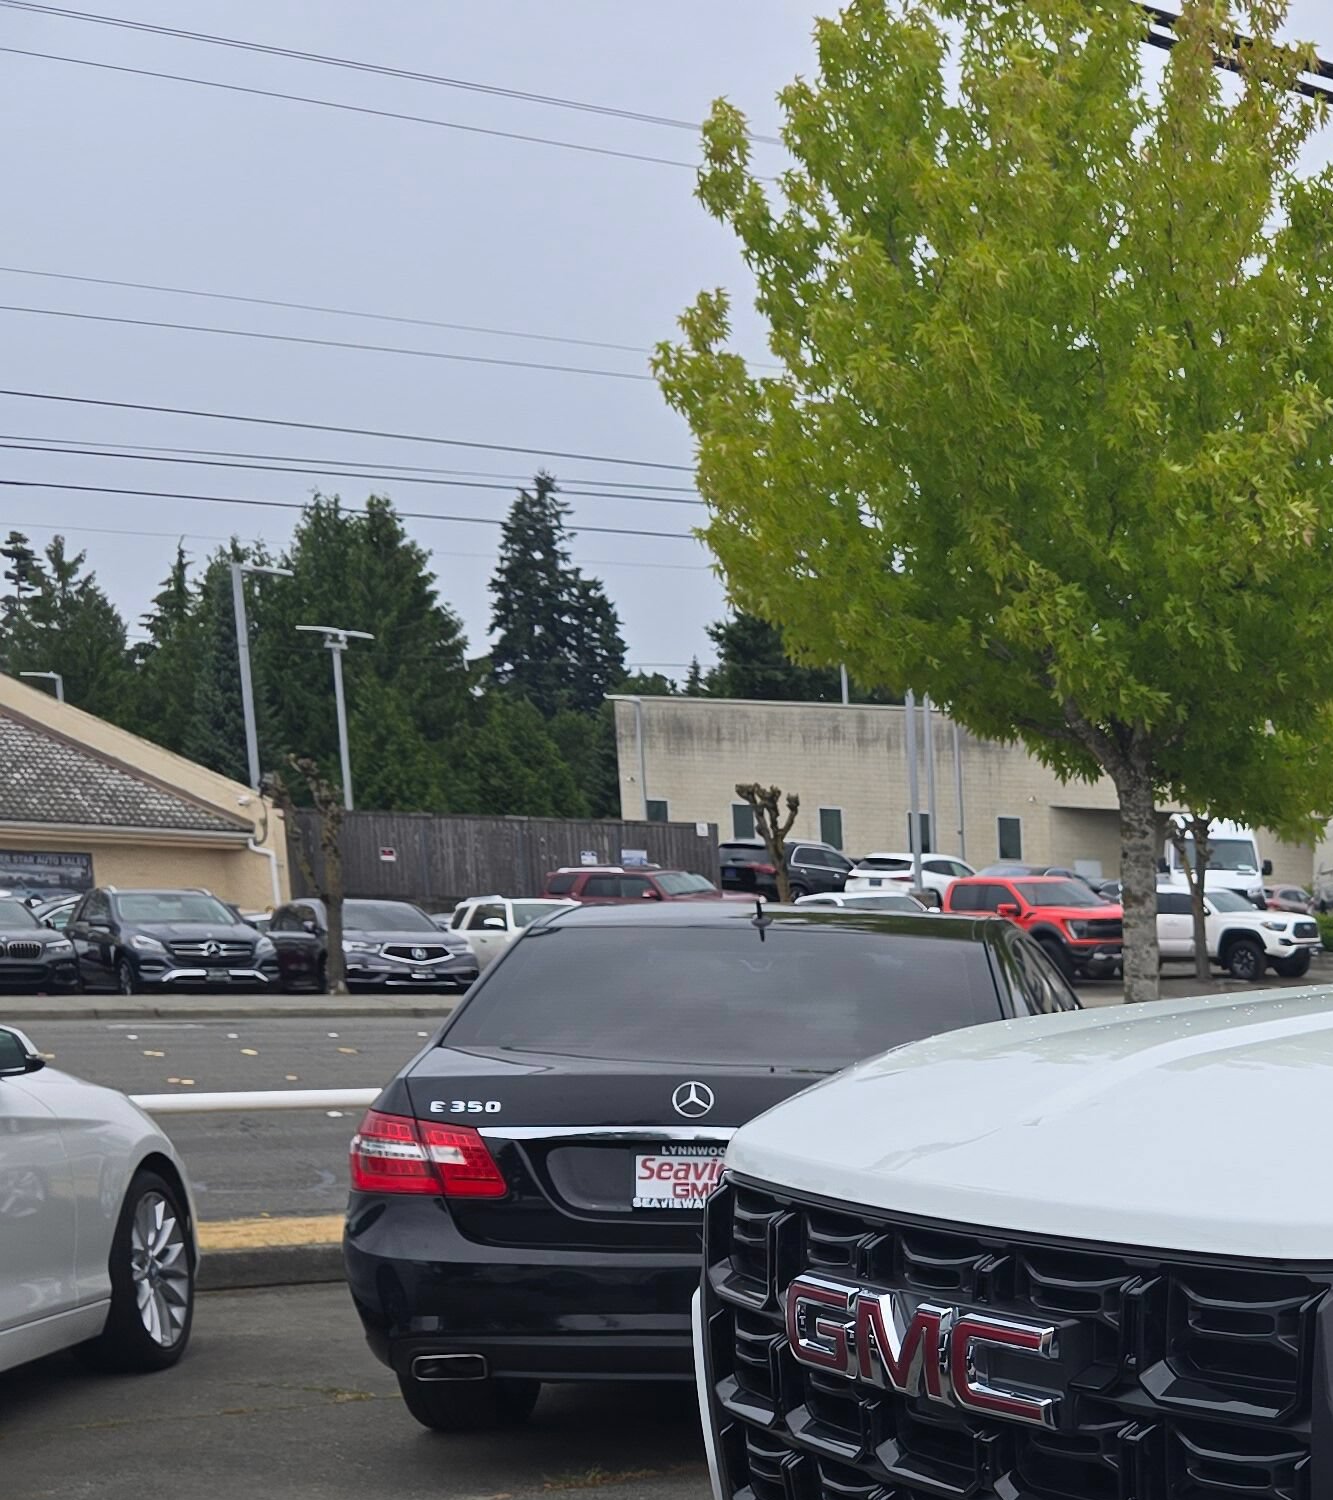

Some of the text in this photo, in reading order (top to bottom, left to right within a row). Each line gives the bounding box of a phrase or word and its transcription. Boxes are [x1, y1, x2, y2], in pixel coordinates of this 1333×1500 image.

[430, 1100, 502, 1113] E 350
[661, 1145, 728, 1156] LYNNWOO
[638, 1157, 727, 1181] Seavi
[785, 1273, 1061, 1430] GMC
